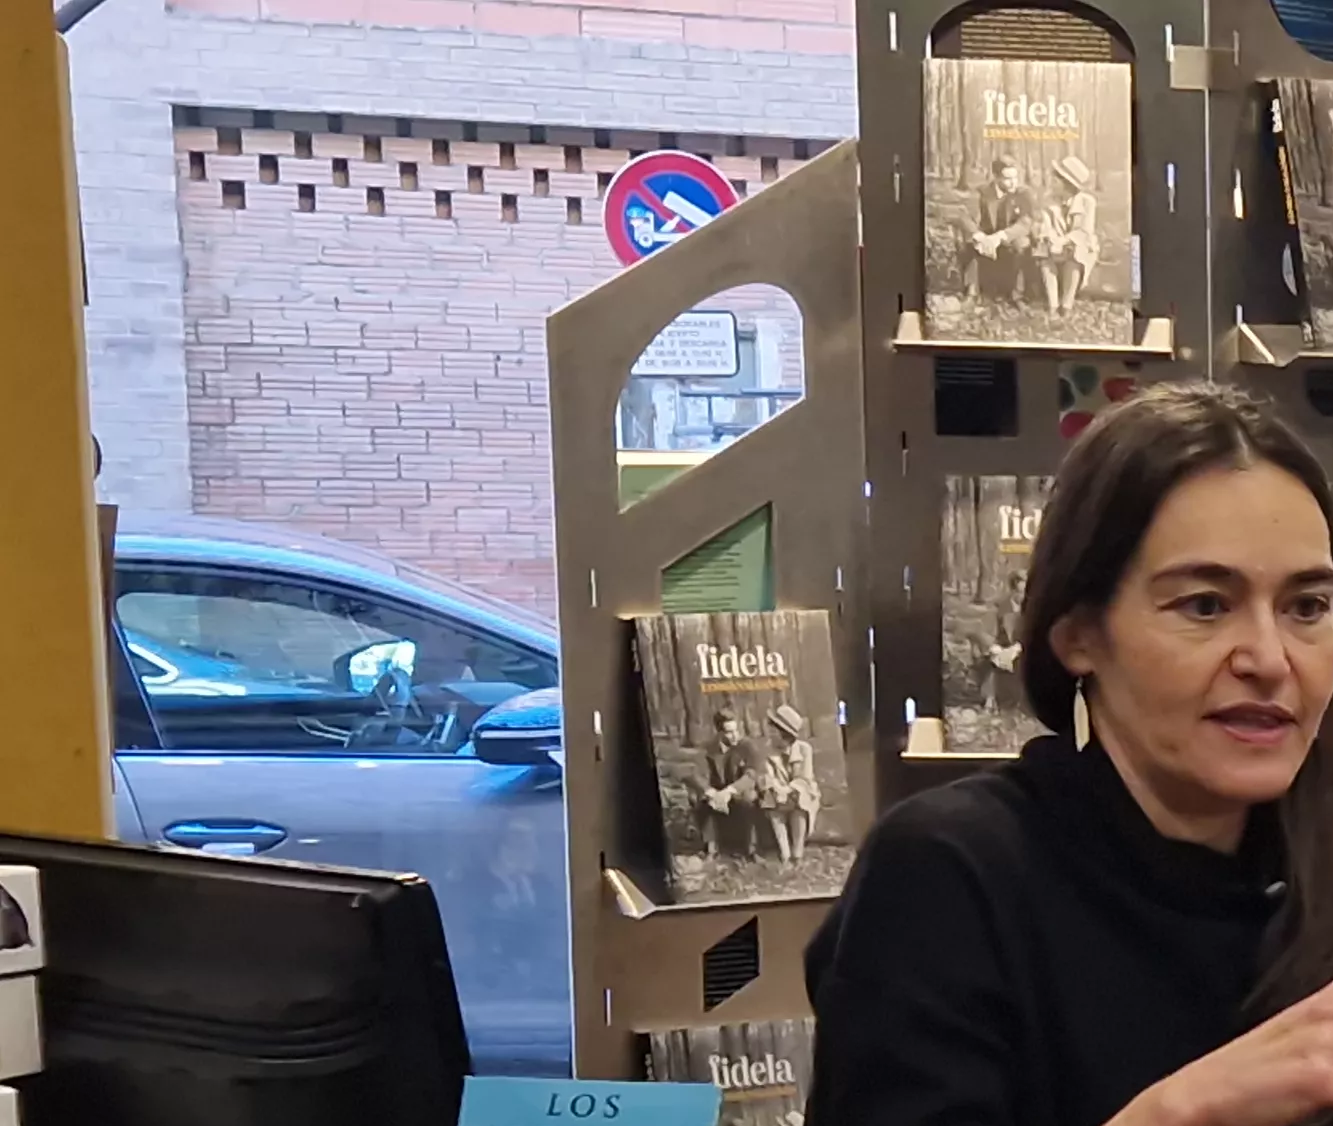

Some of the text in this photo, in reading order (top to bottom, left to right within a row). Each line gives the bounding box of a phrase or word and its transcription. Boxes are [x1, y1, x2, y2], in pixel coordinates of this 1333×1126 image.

[983, 88, 1079, 128] fidela
[998, 504, 1042, 541] fid
[695, 643, 788, 679] fidela
[707, 1052, 797, 1089] fidela
[546, 1092, 622, 1119] LOS
